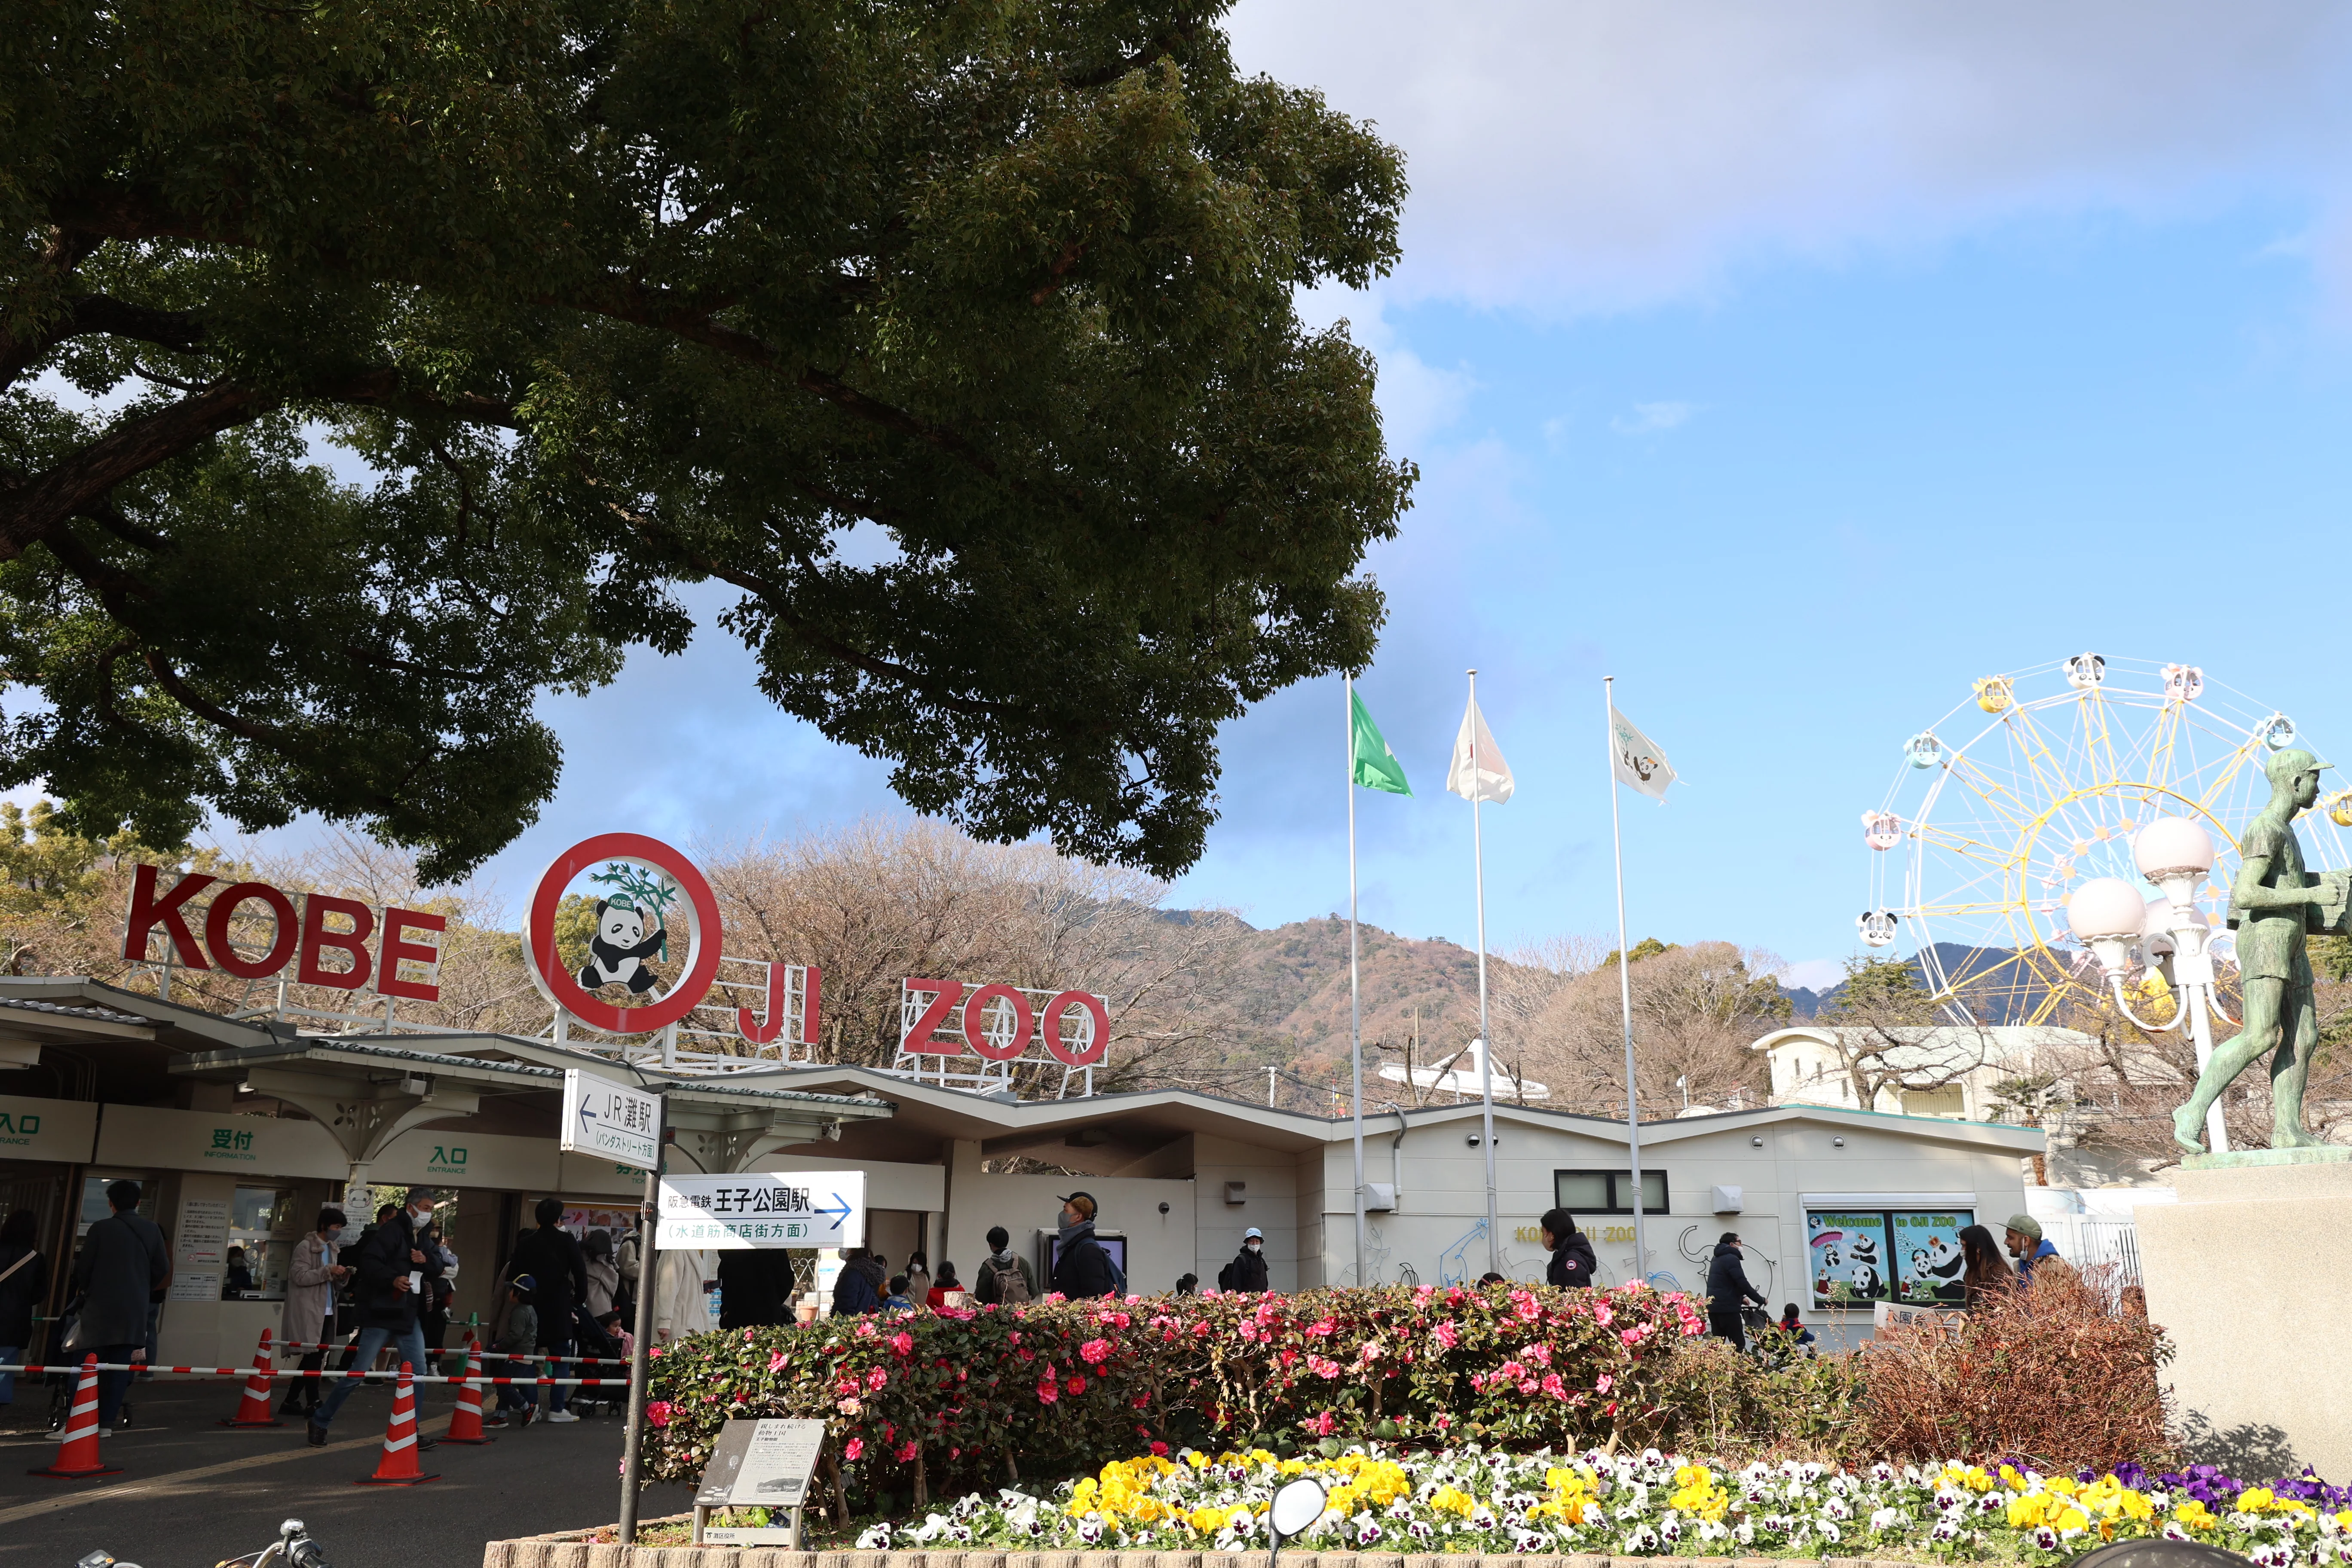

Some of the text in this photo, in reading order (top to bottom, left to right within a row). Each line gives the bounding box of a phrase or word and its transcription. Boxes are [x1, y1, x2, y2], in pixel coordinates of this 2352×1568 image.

[611, 898, 632, 908] KOBE
[122, 863, 446, 1002] KOBE
[903, 977, 1110, 1066] ZOO
[604, 1093, 651, 1133] JR灘駅
[0, 1113, 40, 1134] 入口
[211, 1129, 254, 1150] 受付
[204, 1151, 256, 1160] INFORMATION
[430, 1146, 467, 1164] 入口
[668, 1188, 809, 1213] 阪急電鉄 王子公園駅
[1823, 1215, 1882, 1227] Welcome
[1895, 1216, 1957, 1227] to OJI ZOO
[1606, 1226, 1636, 1242] ZOO
